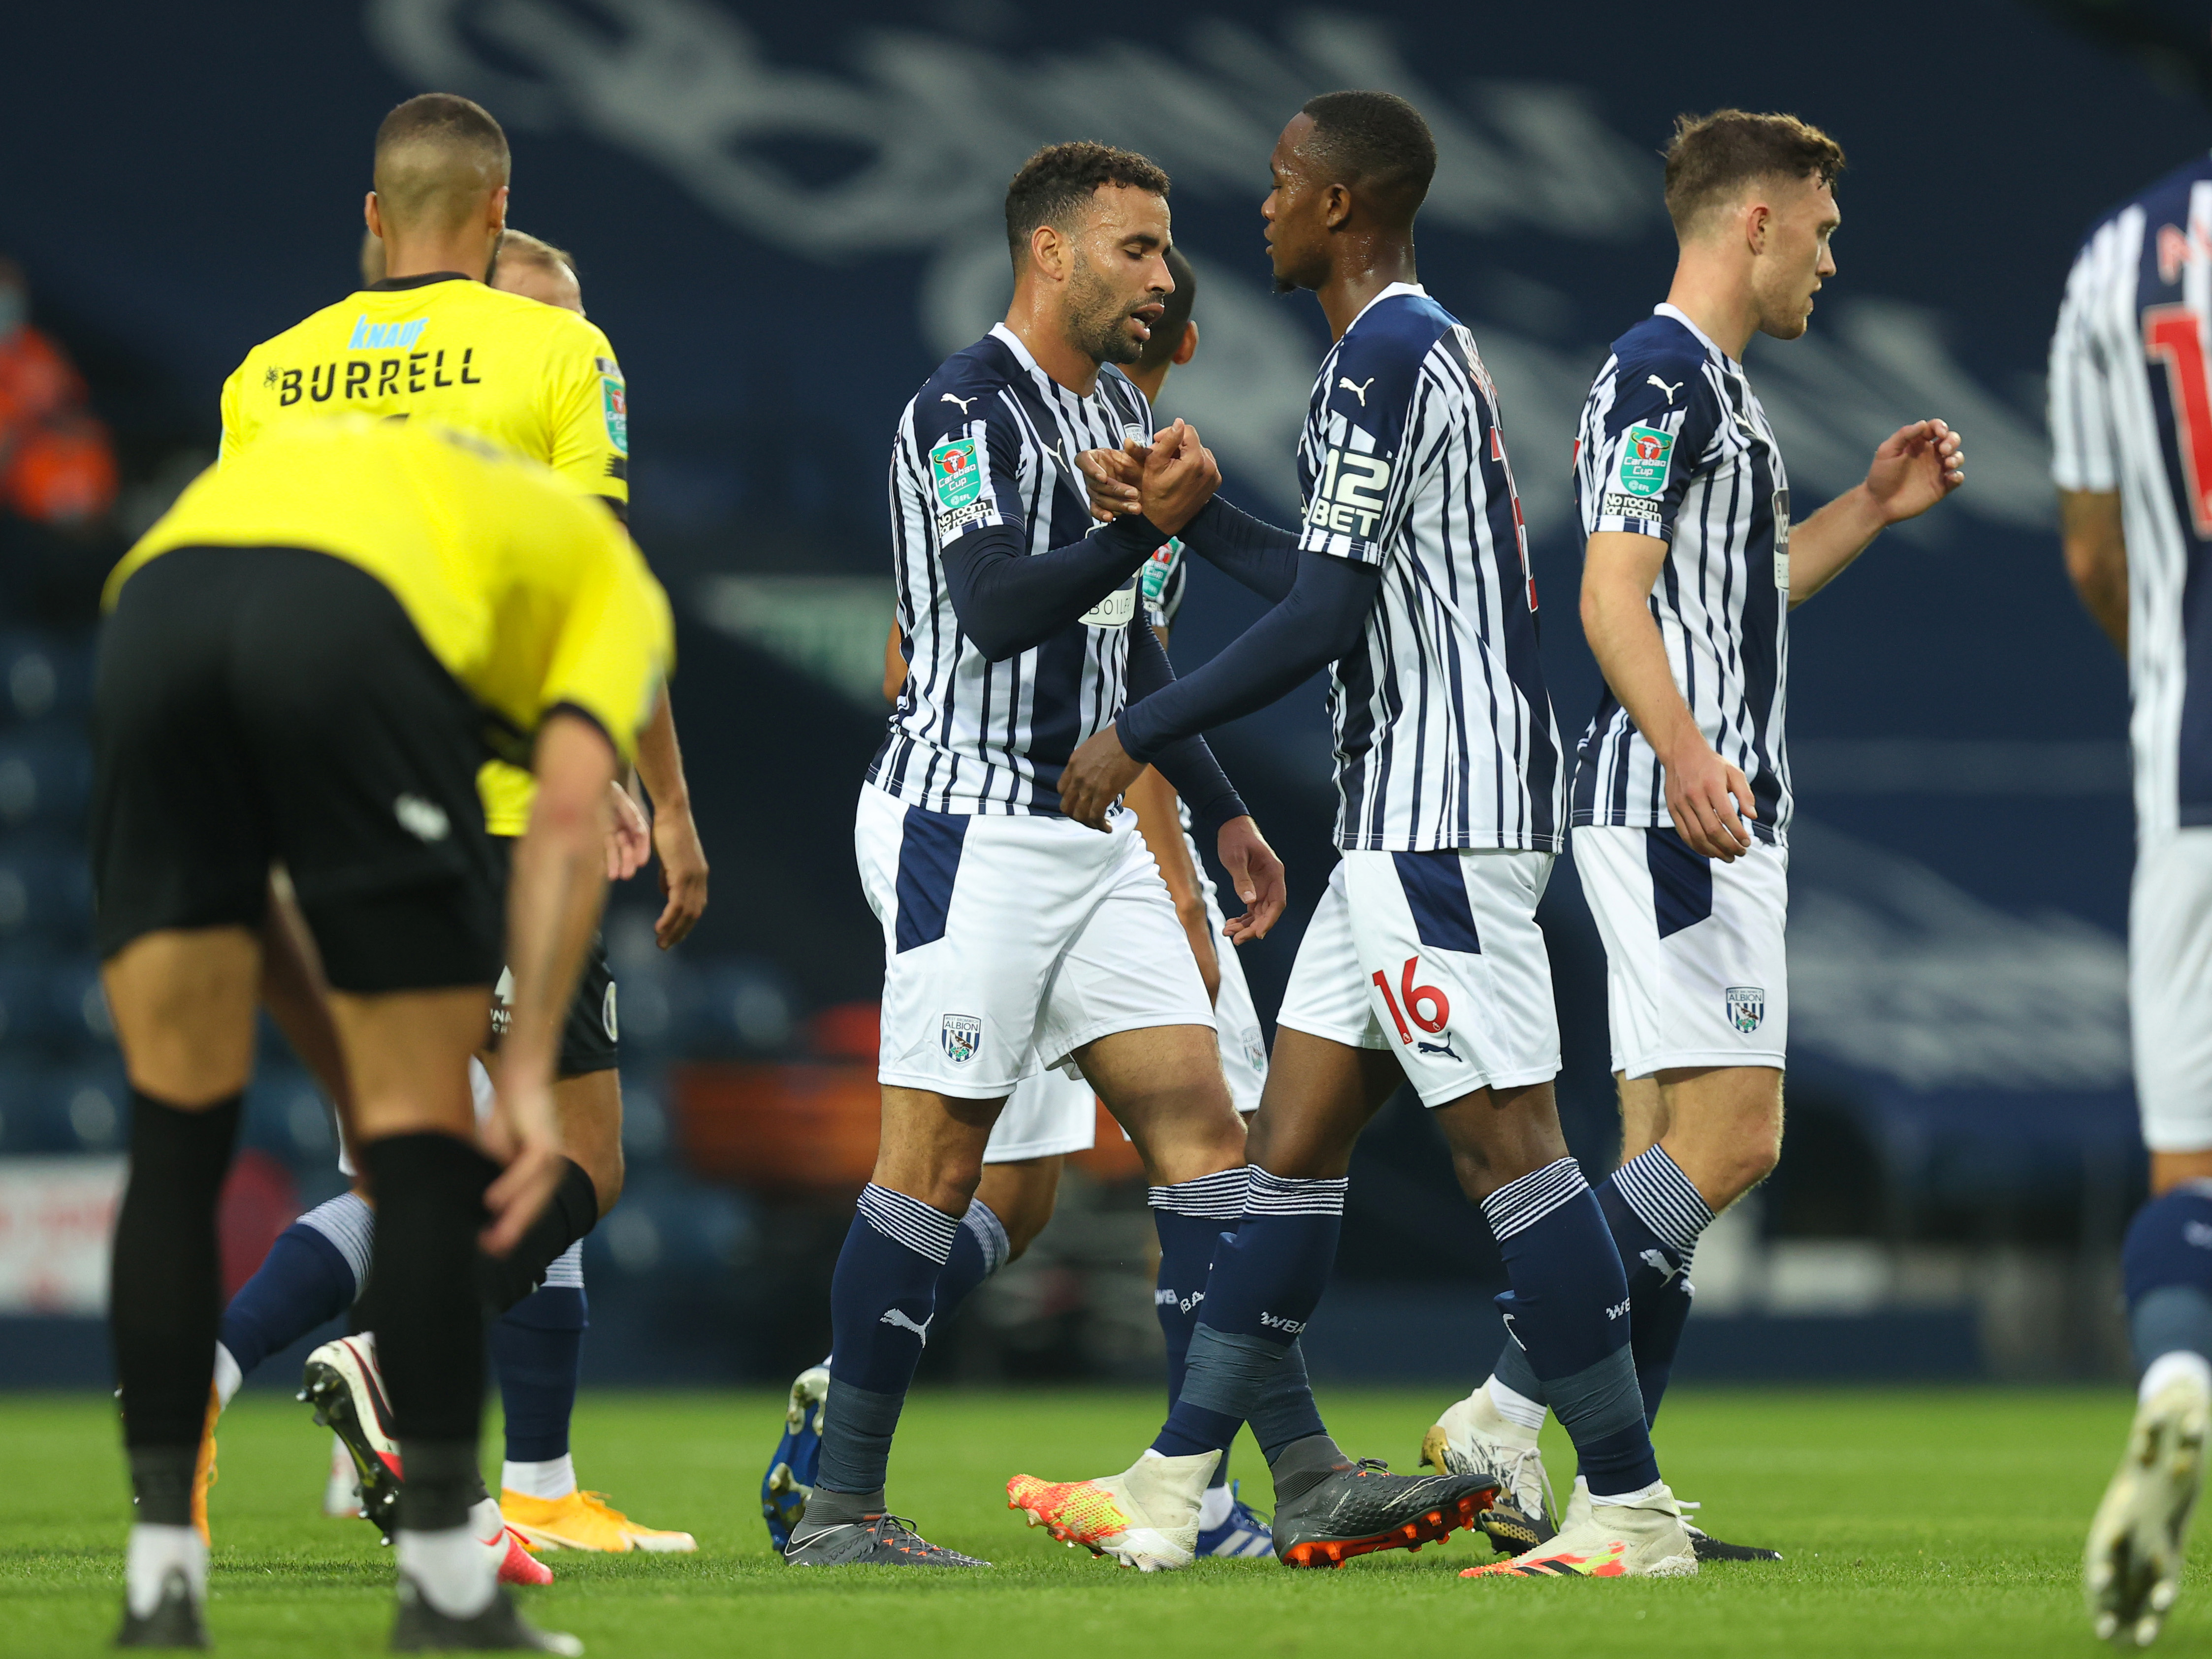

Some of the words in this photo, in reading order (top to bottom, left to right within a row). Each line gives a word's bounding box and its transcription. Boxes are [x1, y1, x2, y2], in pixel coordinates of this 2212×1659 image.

[280, 348, 481, 406] BURRELL
[1624, 456, 1667, 467] Carabao
[1633, 466, 1654, 476] Cup
[938, 463, 977, 488] Carabao
[948, 477, 967, 491] Cup
[1321, 448, 1390, 511] 12
[960, 493, 971, 502] EFL
[1606, 493, 1623, 506] No
[1623, 497, 1658, 512] room
[937, 514, 951, 526] No
[952, 502, 987, 519] room
[953, 508, 994, 528] racism
[1310, 498, 1381, 537] BET
[1621, 507, 1662, 522] racism
[1372, 955, 1449, 1045] 16
[945, 1021, 978, 1031] ALBION
